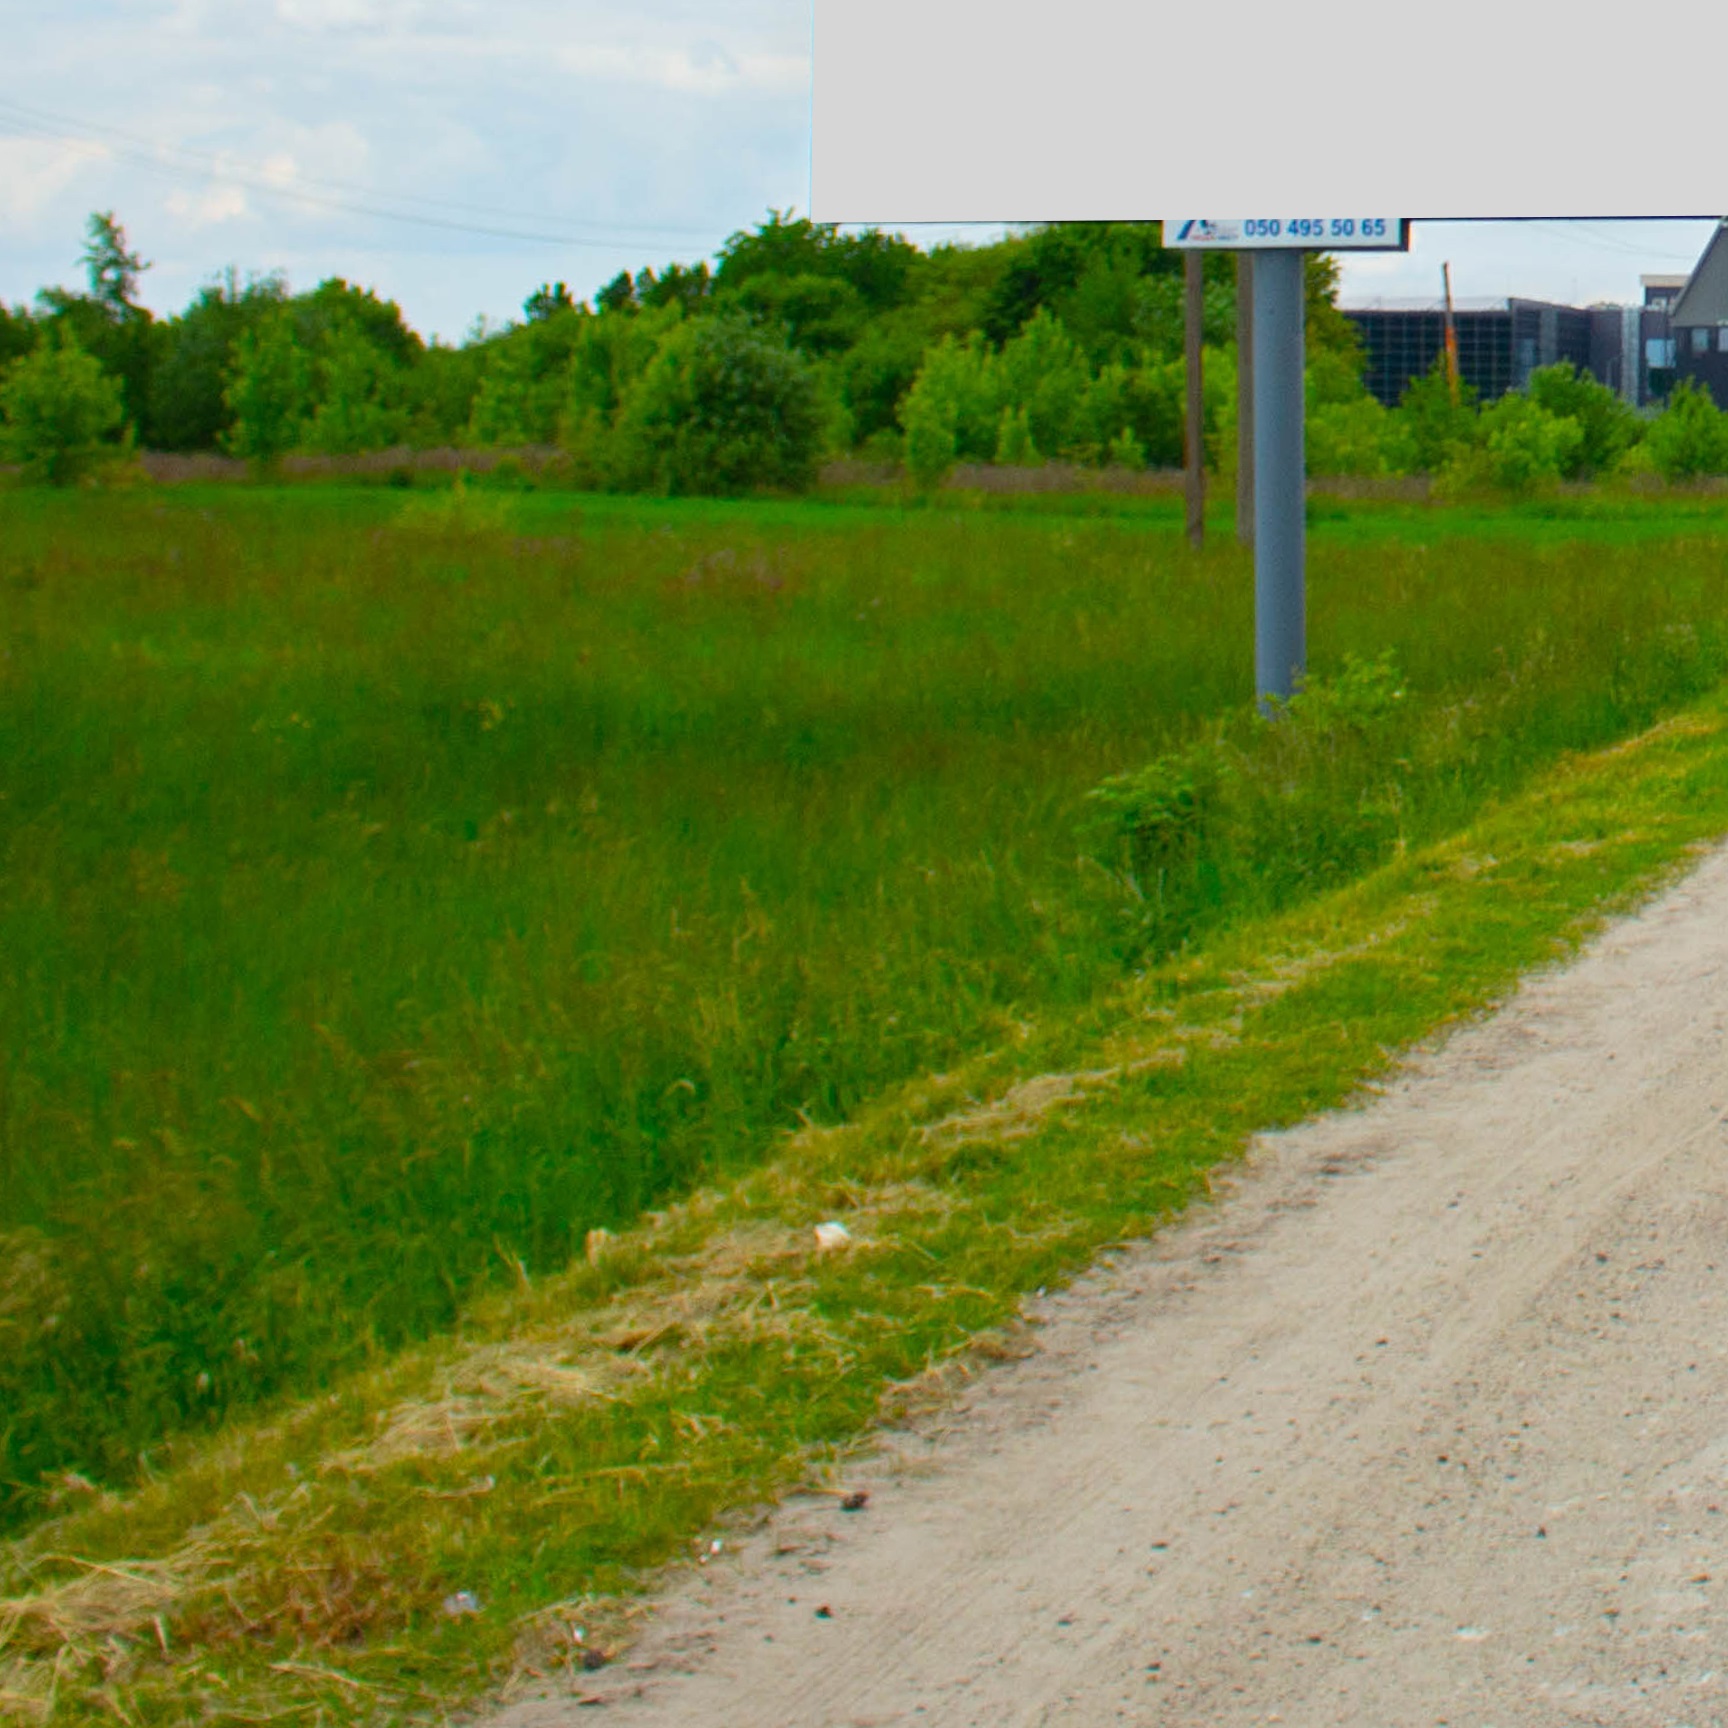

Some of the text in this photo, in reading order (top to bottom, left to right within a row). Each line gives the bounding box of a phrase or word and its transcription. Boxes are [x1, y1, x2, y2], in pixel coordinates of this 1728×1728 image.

[1244, 218, 1386, 237] 050 495 50 65
